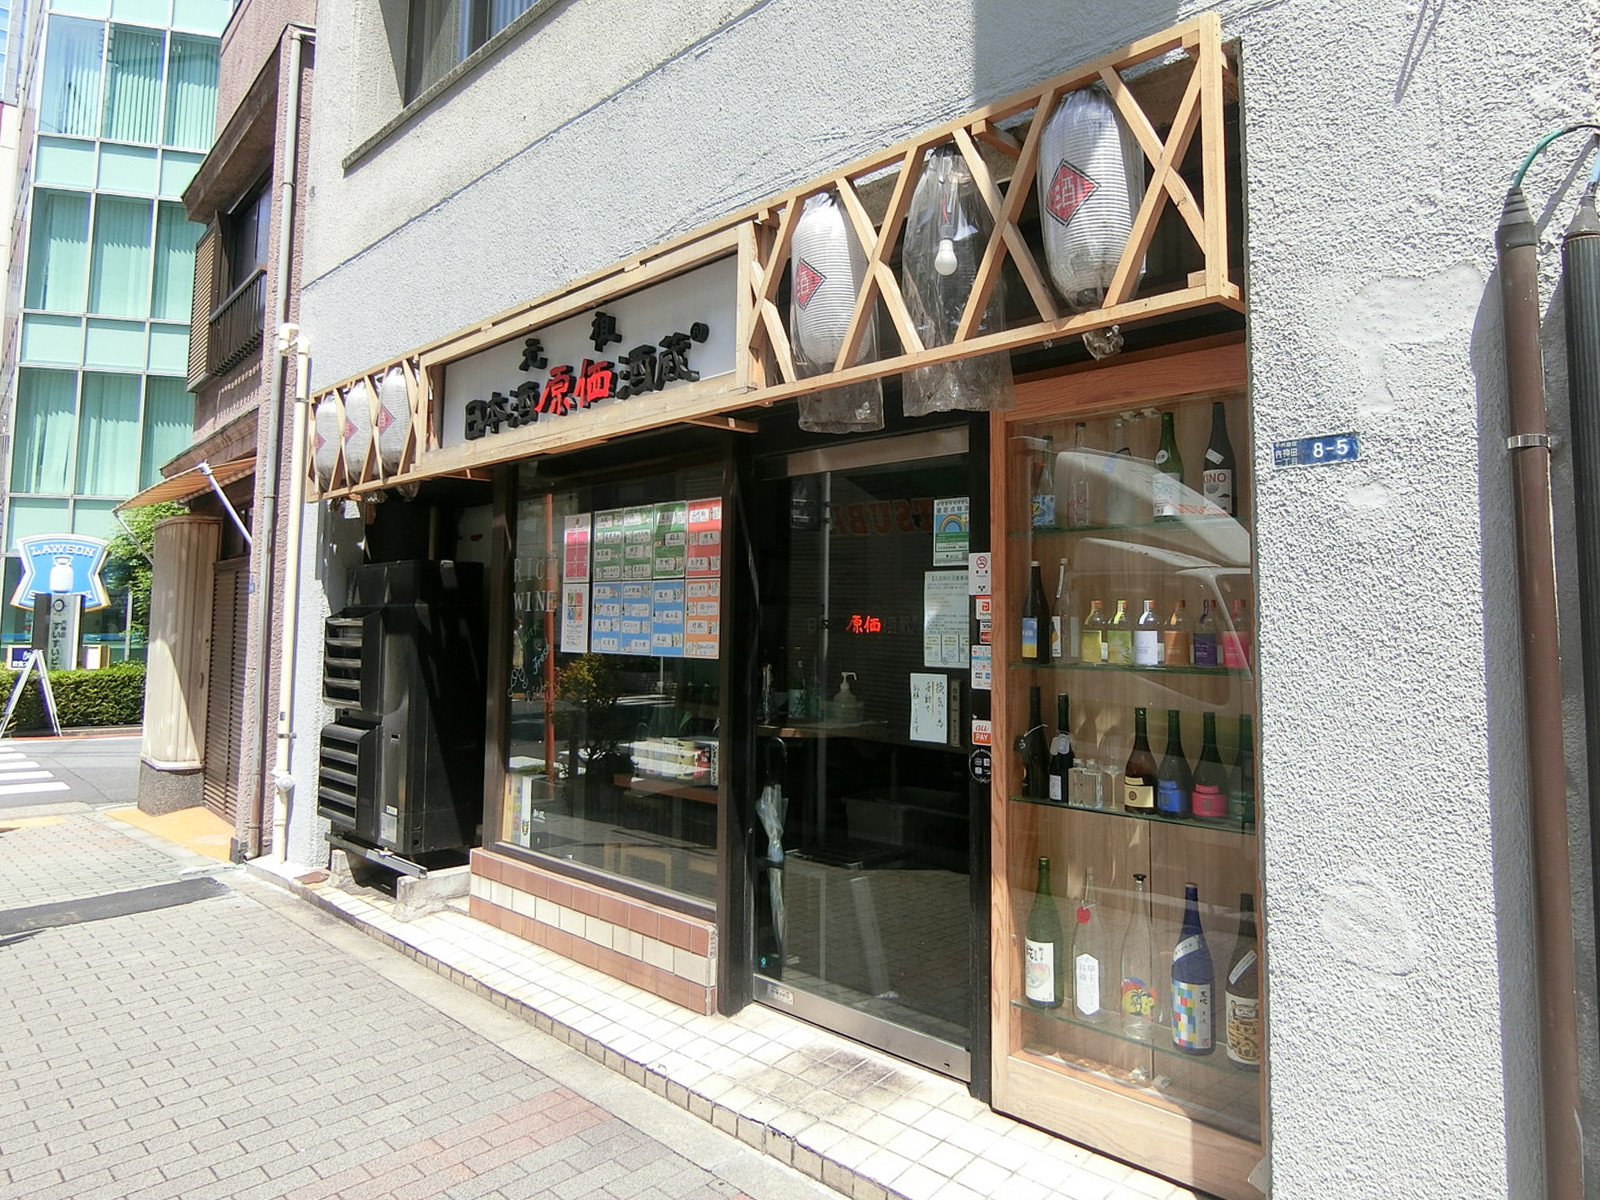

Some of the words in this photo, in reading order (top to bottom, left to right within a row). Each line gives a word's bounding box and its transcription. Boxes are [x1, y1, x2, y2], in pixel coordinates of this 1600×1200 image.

[1312, 438, 1349, 458] 8-5
[31, 543, 97, 557] LAWSON
[513, 590, 558, 613] WINE
[975, 732, 988, 741] PAY
